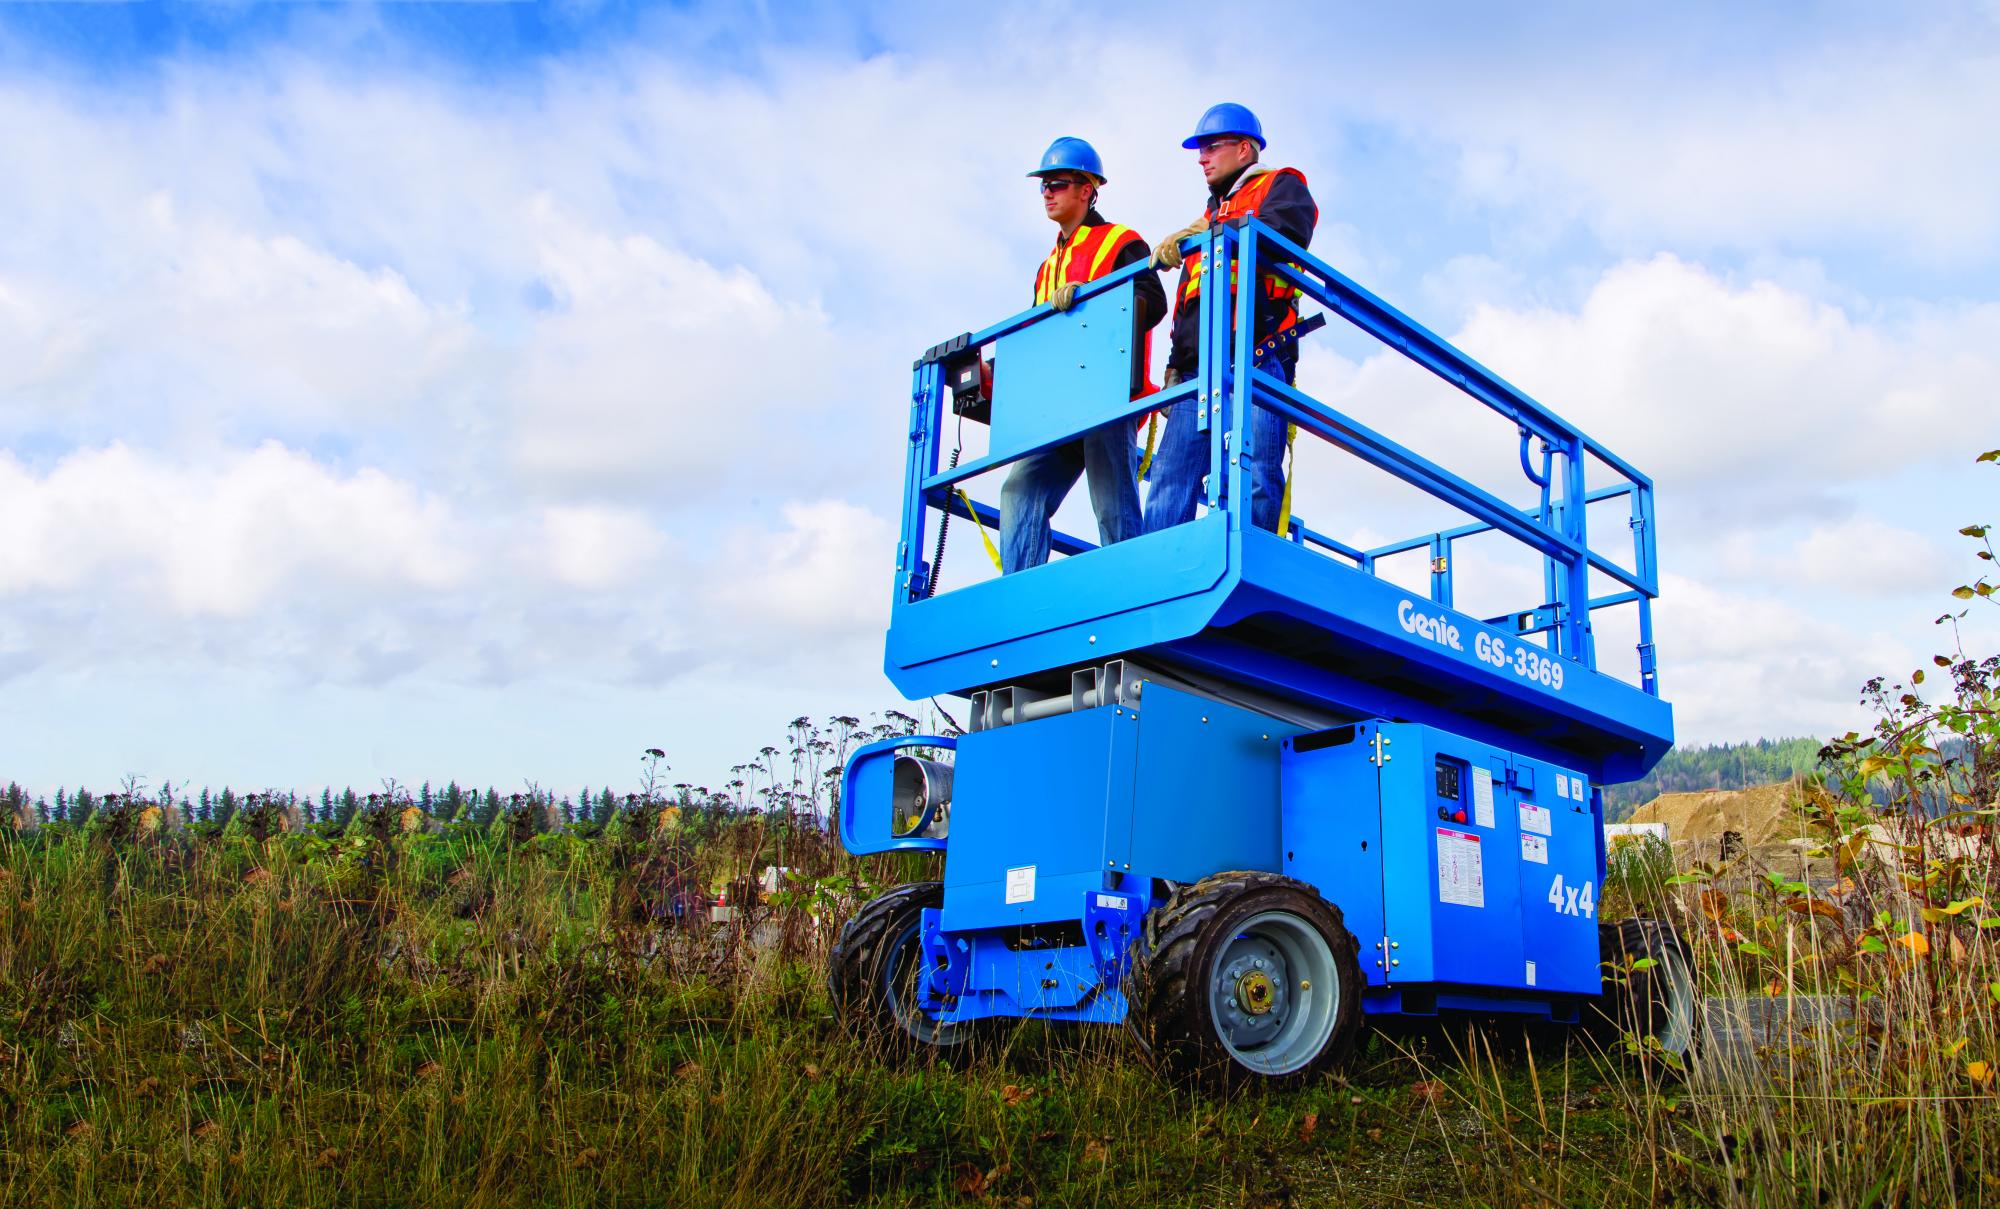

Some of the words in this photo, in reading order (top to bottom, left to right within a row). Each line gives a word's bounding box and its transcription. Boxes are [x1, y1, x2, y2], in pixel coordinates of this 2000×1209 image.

[1398, 599, 1464, 652] Genie
[1475, 631, 1564, 690] GS-3369
[1548, 874, 1594, 919] 4x4
